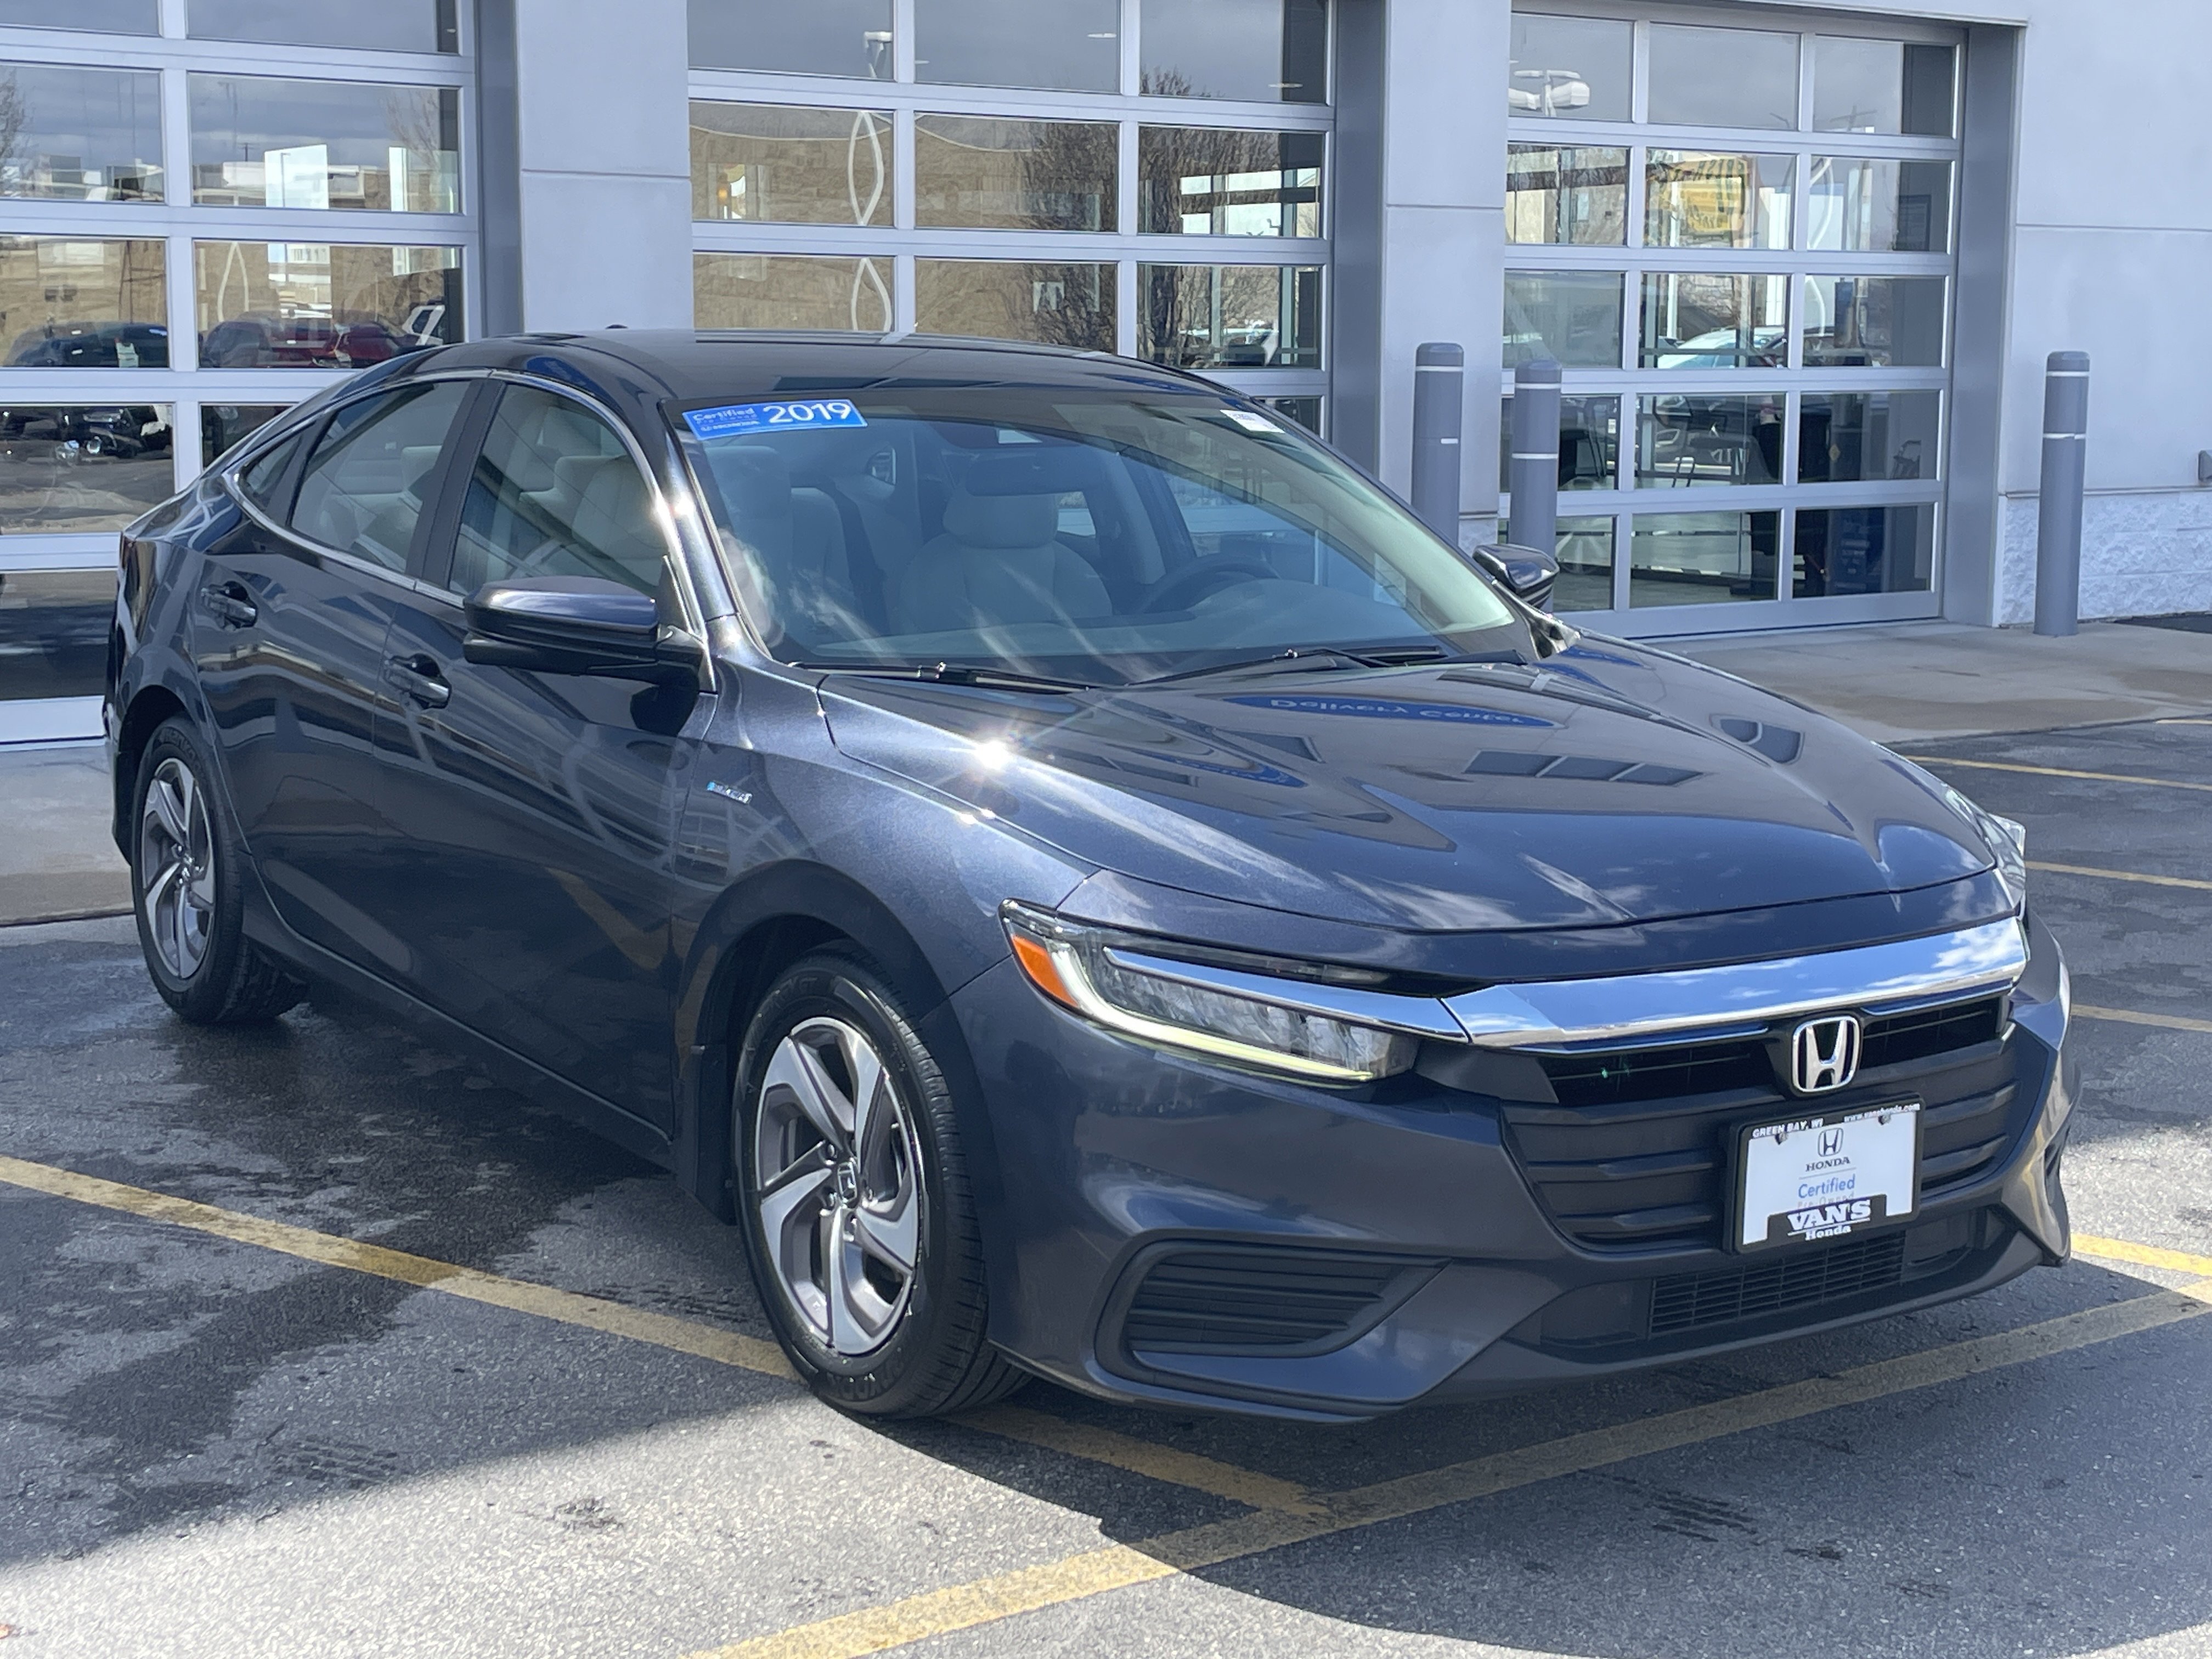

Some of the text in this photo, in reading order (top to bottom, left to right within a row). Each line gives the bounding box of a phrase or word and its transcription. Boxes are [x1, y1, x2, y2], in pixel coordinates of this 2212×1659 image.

[692, 407, 757, 421] Certified
[763, 402, 851, 423] 2019
[1752, 1124, 1786, 1138] GREEN
[1805, 1156, 1850, 1172] HONDA
[1798, 1173, 1855, 1198] Certified
[1805, 1225, 1852, 1241] Honda
